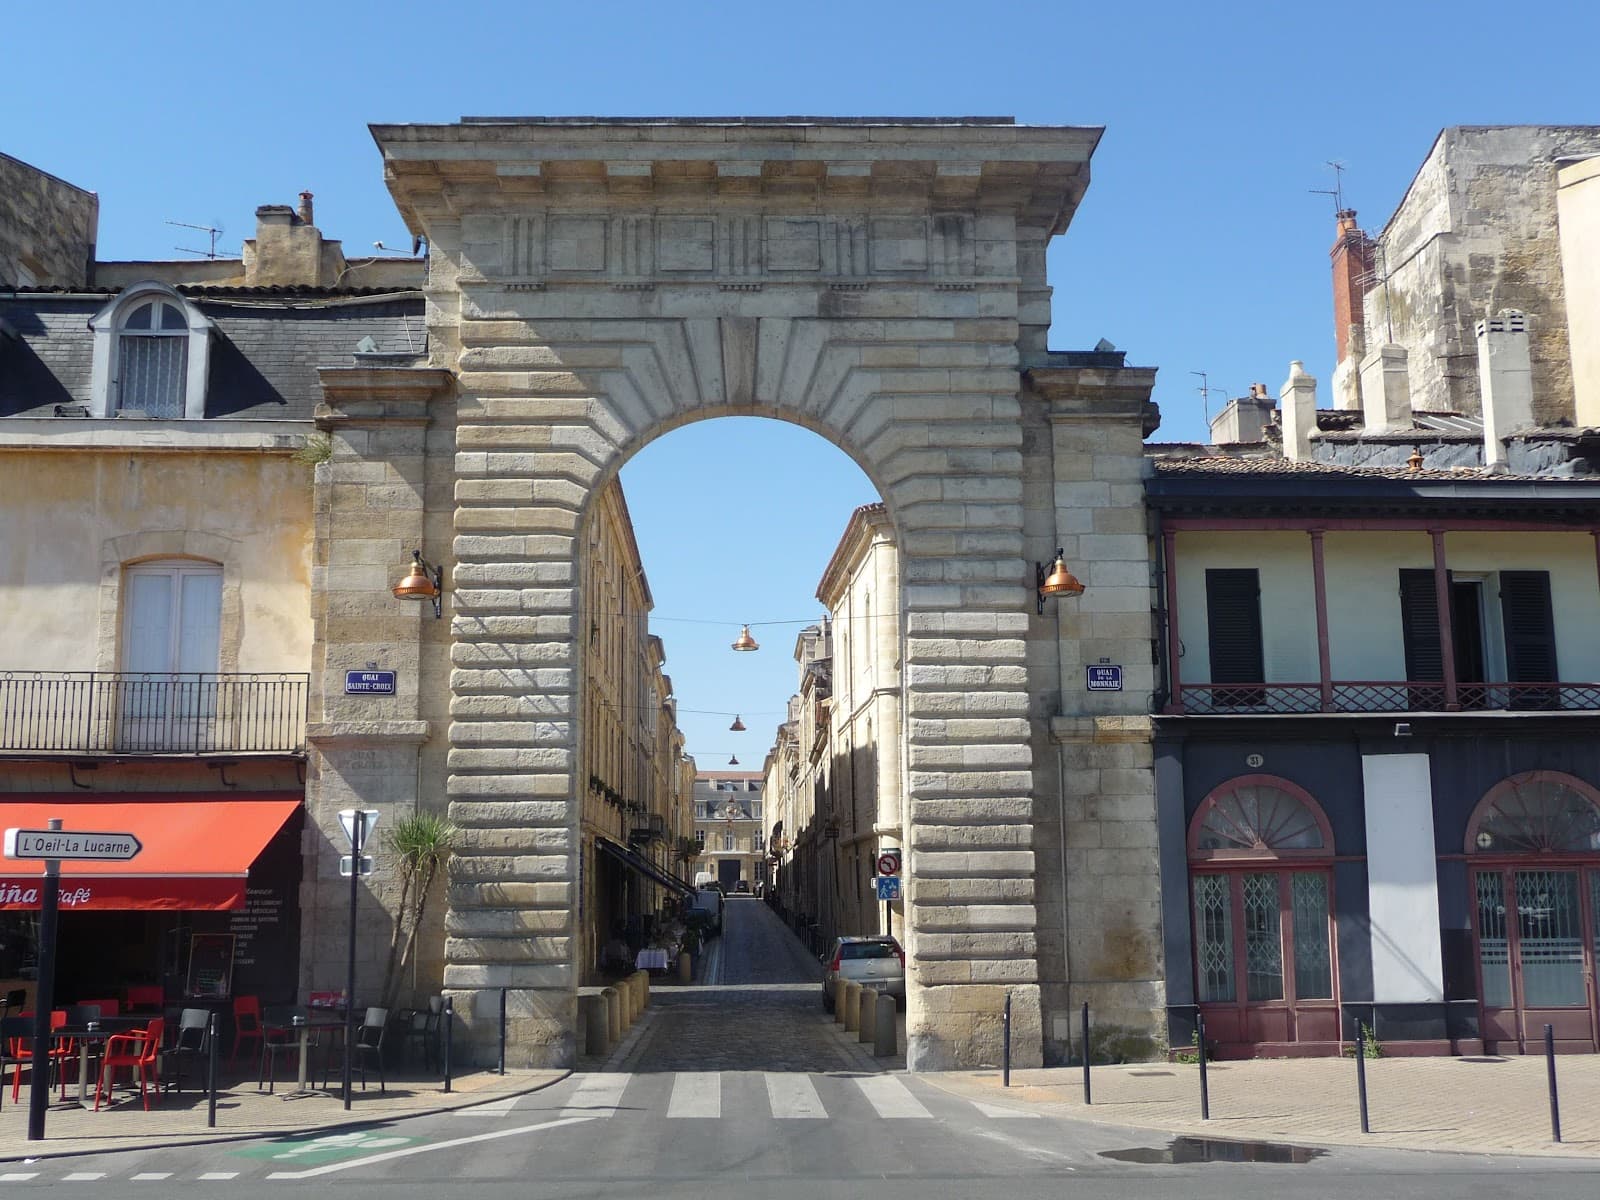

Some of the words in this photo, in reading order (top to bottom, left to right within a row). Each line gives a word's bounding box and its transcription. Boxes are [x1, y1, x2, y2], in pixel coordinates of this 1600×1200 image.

[362, 673, 379, 681] QUAI
[347, 682, 392, 690] SAINTE-CROIX
[83, 839, 130, 853] Lucarne
